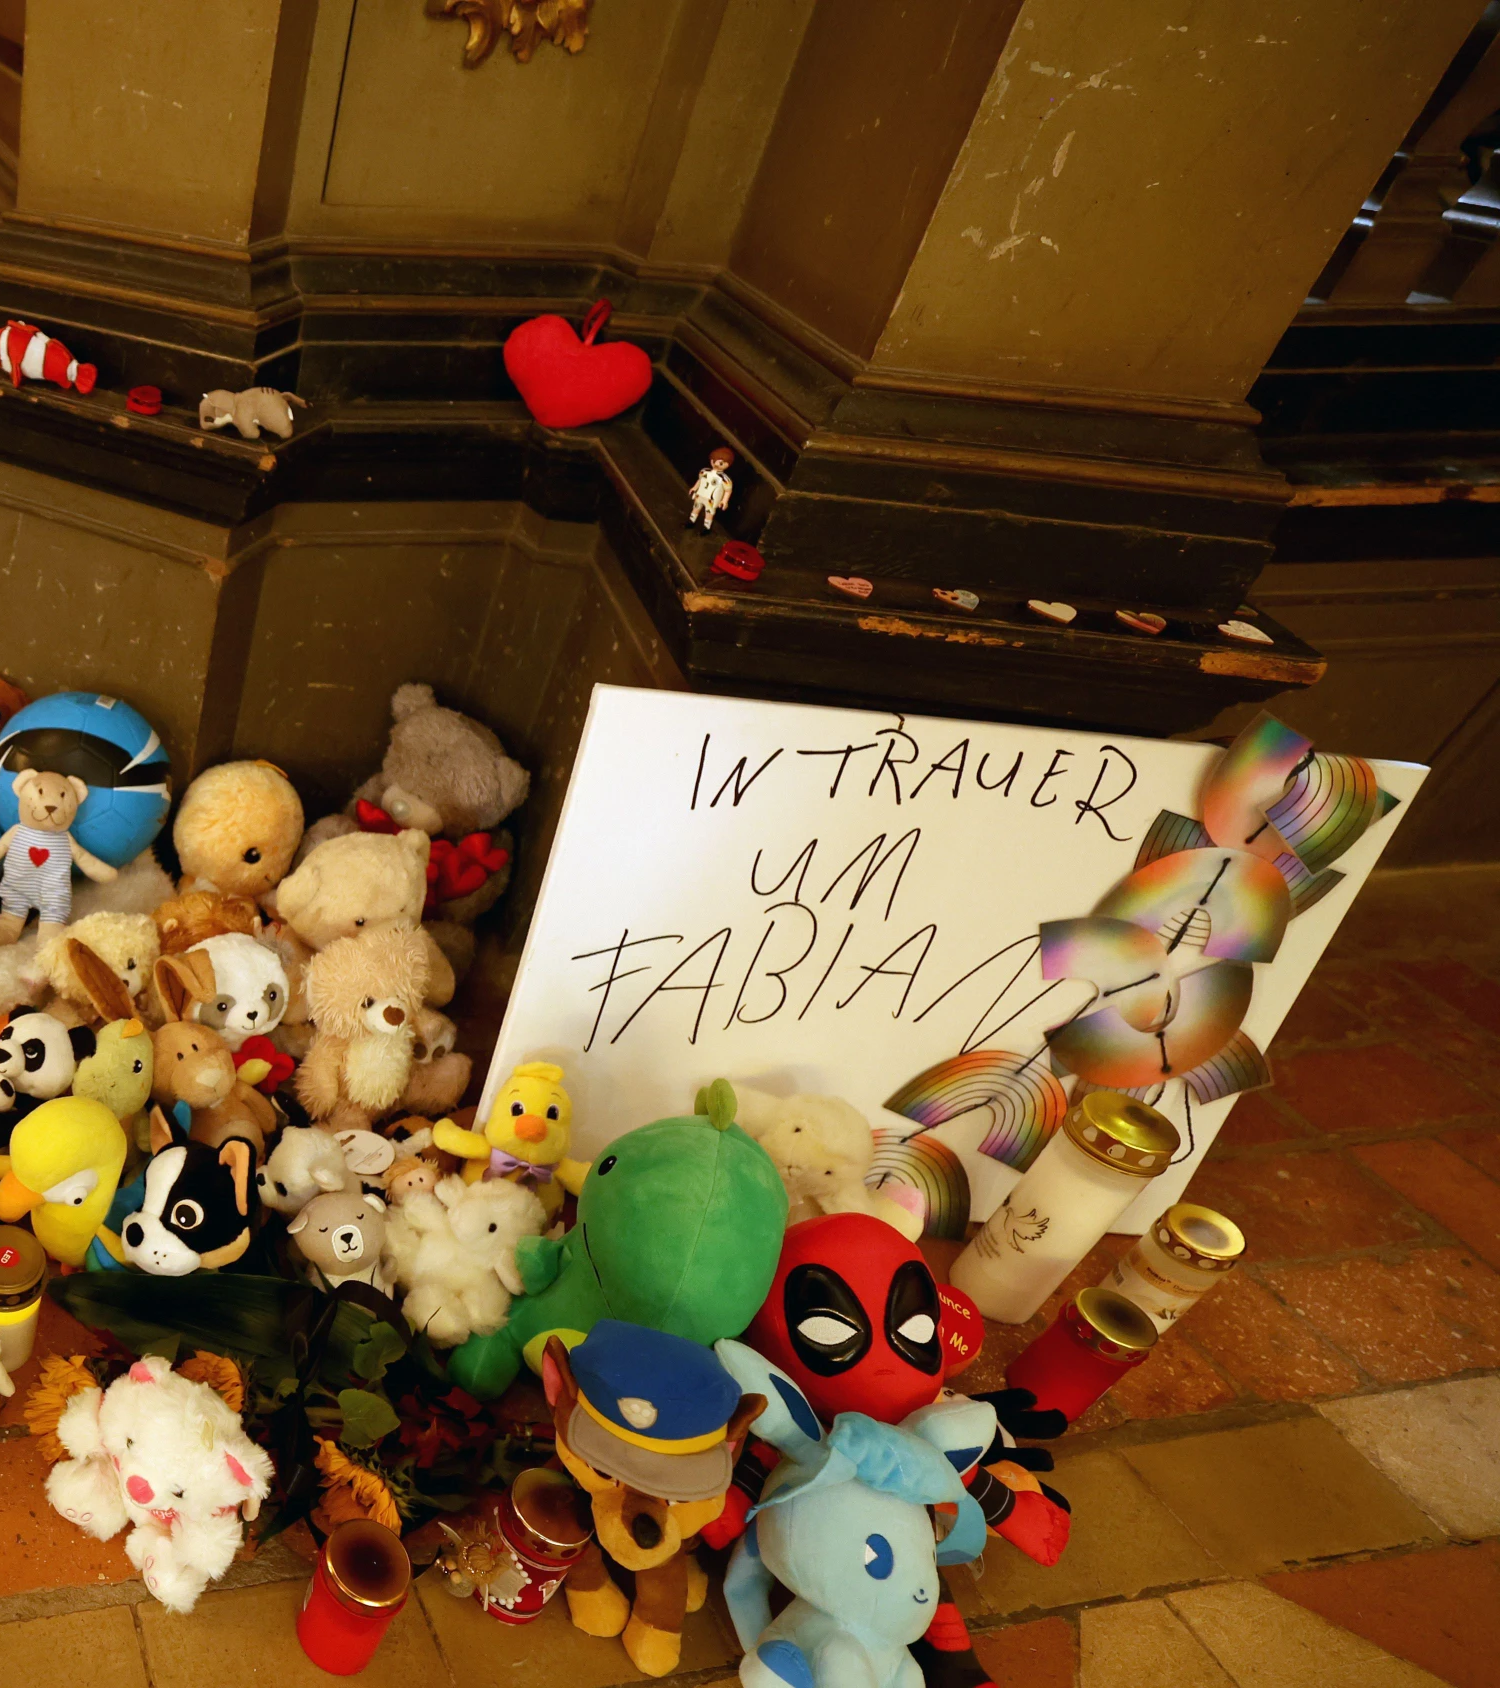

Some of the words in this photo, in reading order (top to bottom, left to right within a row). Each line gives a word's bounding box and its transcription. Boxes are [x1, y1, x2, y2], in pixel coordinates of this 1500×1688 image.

[690, 733, 785, 810] IN
[796, 728, 1138, 842] TRAUER
[749, 827, 922, 922] UM
[571, 901, 1067, 1055] FABIAN
[0, 1249, 14, 1264] LED
[938, 1291, 972, 1320] unce
[949, 1331, 969, 1356] Me
